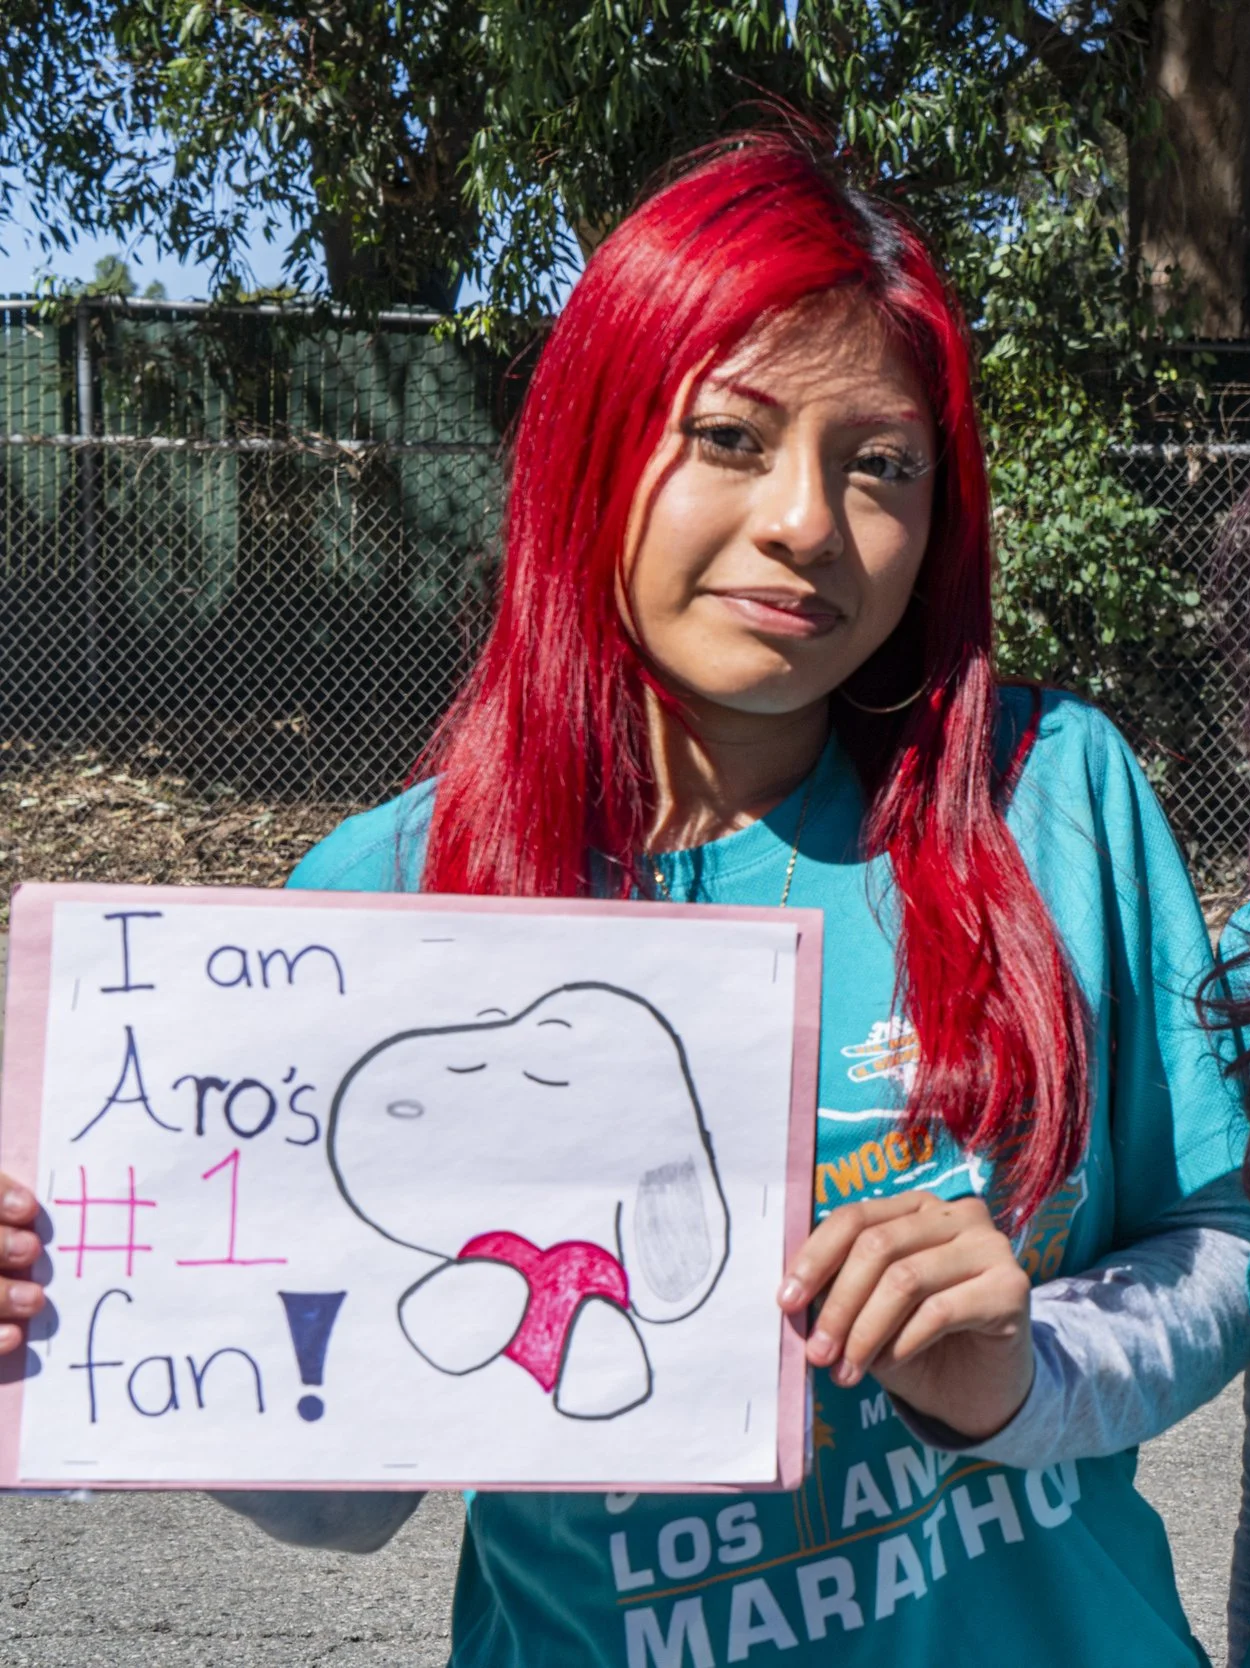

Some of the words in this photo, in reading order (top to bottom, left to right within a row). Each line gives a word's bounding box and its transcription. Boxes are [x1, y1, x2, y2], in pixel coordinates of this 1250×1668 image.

[100, 911, 163, 993] I
[206, 945, 344, 995] am
[70, 1025, 320, 1146] Aro's
[54, 1148, 288, 1278] #1
[68, 1288, 348, 1423] fan!
[610, 1501, 763, 1592] LOS
